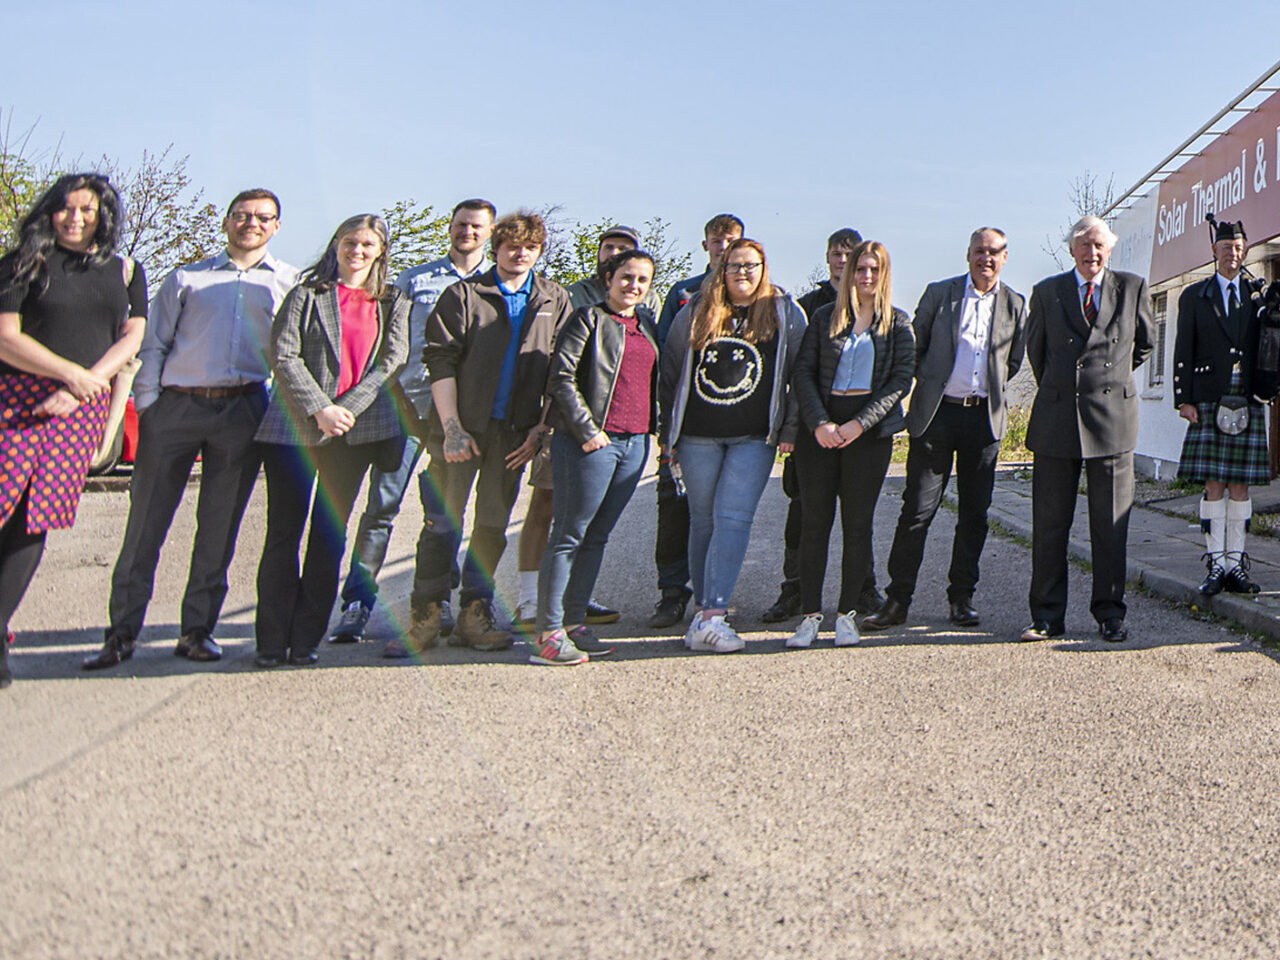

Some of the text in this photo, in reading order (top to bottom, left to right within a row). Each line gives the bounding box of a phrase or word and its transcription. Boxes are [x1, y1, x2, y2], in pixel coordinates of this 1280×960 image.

[1158, 198, 1187, 247] Solar
[1192, 149, 1246, 227] Thermal
[1253, 138, 1267, 193] &
